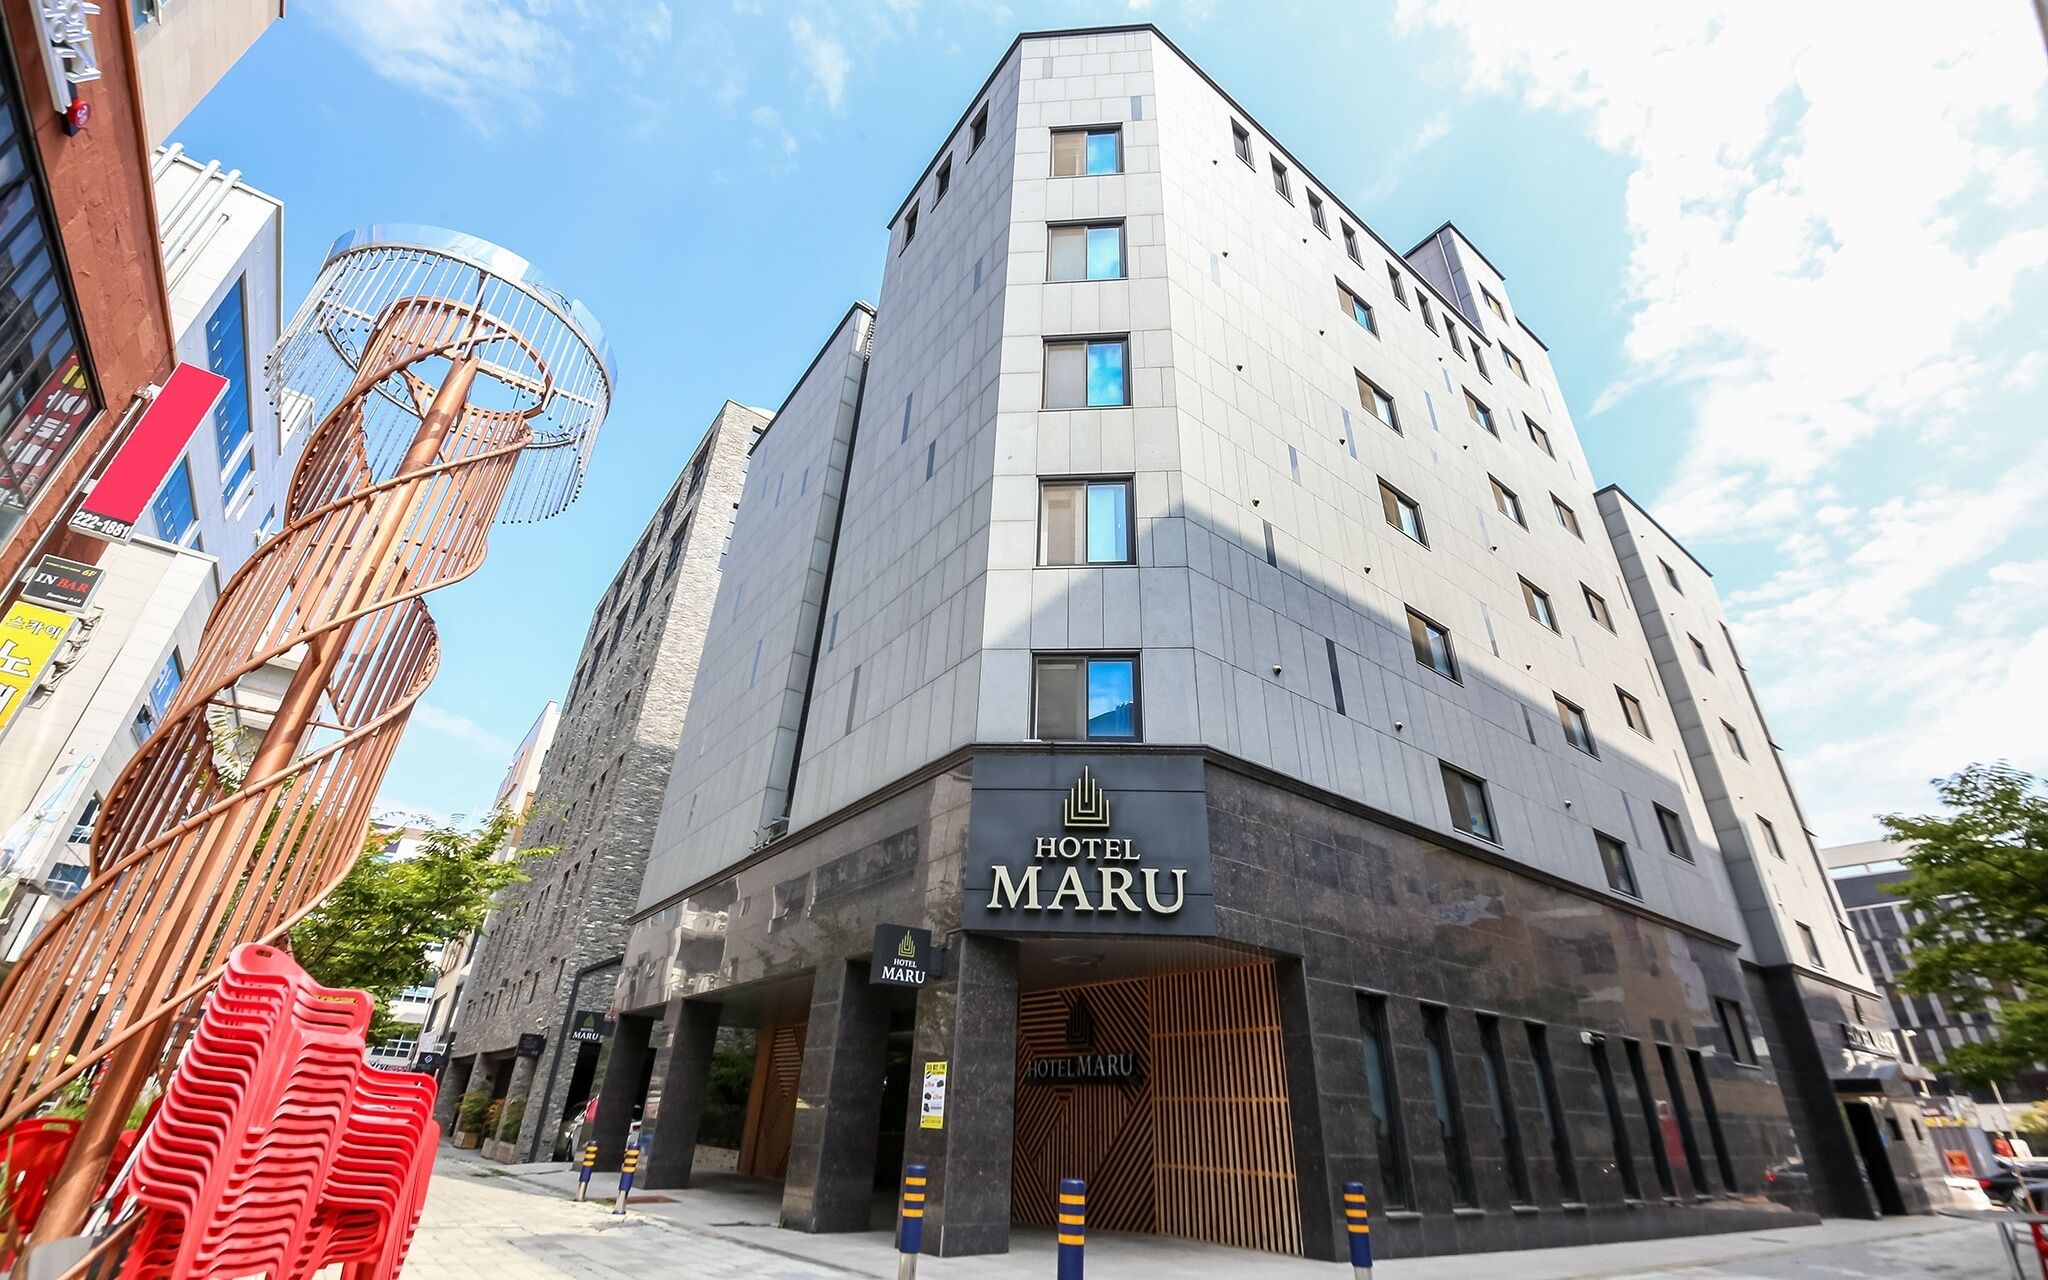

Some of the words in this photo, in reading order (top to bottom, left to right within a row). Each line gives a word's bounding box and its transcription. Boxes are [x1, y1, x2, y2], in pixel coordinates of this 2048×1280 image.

[70, 510, 131, 539] 222-1881
[34, 572, 59, 585] IN
[56, 577, 90, 593] BAR
[5, 615, 64, 640] 스카이
[1034, 836, 1141, 861] HOTEL
[986, 864, 1188, 914] MARU
[881, 965, 926, 984] MARU
[893, 957, 917, 968] HOTEL
[572, 1031, 599, 1040] MARU
[1027, 1058, 1075, 1078] HOTEL
[1076, 1053, 1134, 1077] MARU
